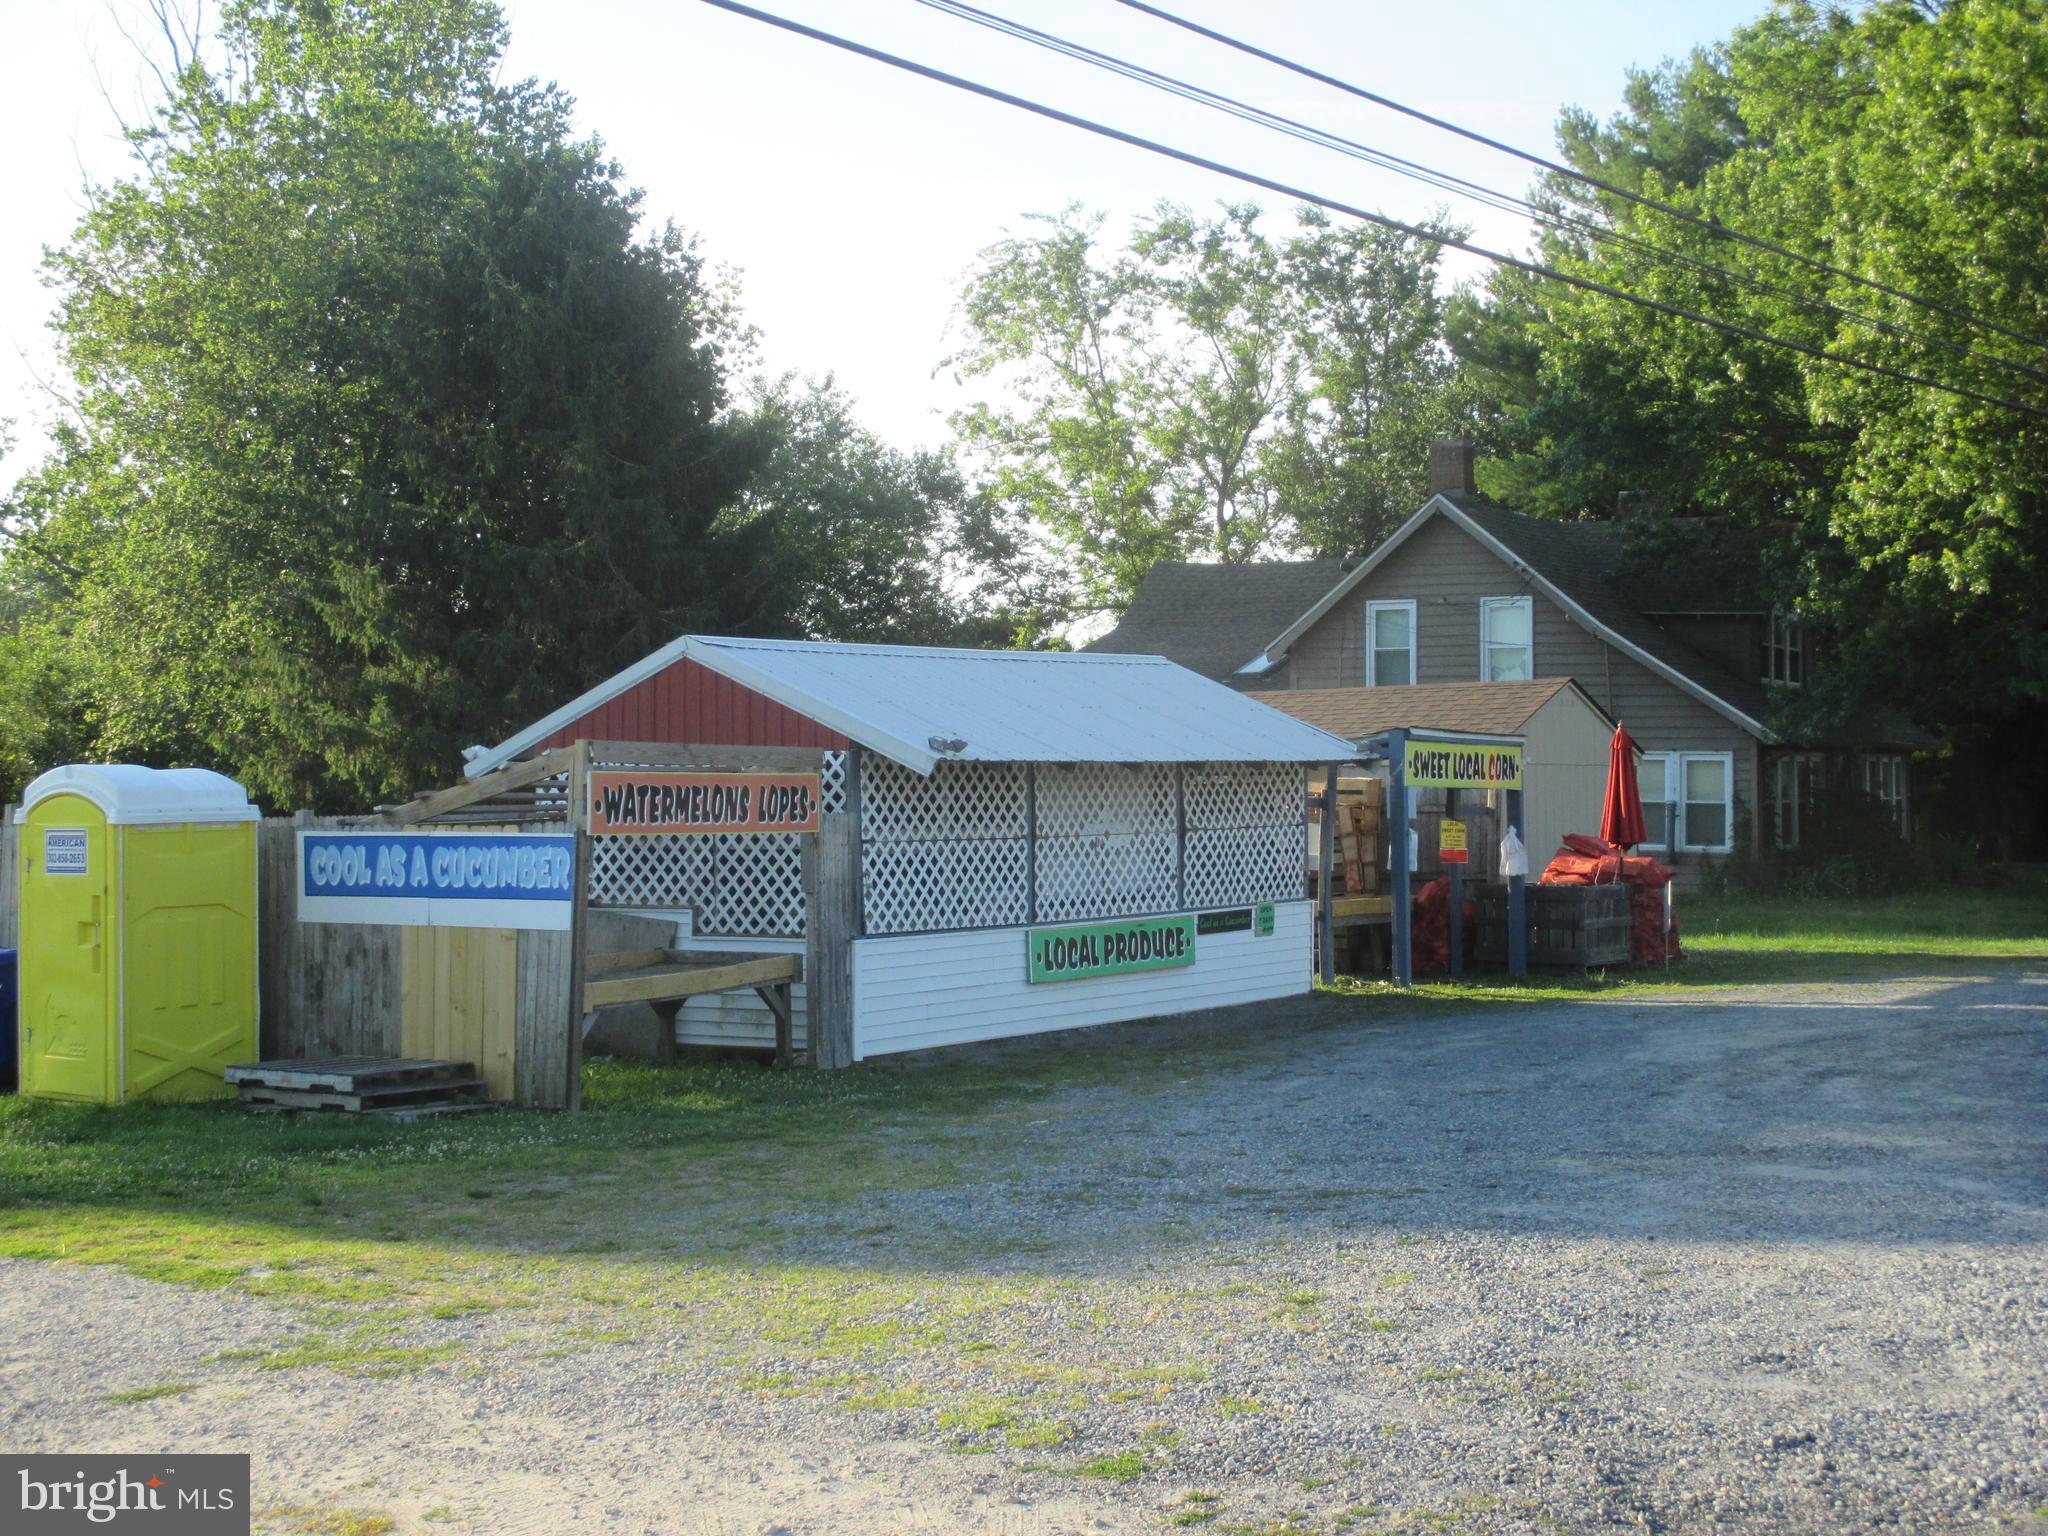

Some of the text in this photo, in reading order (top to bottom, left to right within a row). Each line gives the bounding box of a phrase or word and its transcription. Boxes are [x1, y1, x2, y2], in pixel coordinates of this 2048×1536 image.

[1413, 750, 1515, 780] SWEET LOCAL CORN
[603, 783, 810, 825] WATERMELONS LOPES
[48, 838, 84, 847] AMERICAN
[310, 844, 571, 891] COOL AS A CUCUMBER
[1044, 927, 1186, 973] LOCAL PRODUCE
